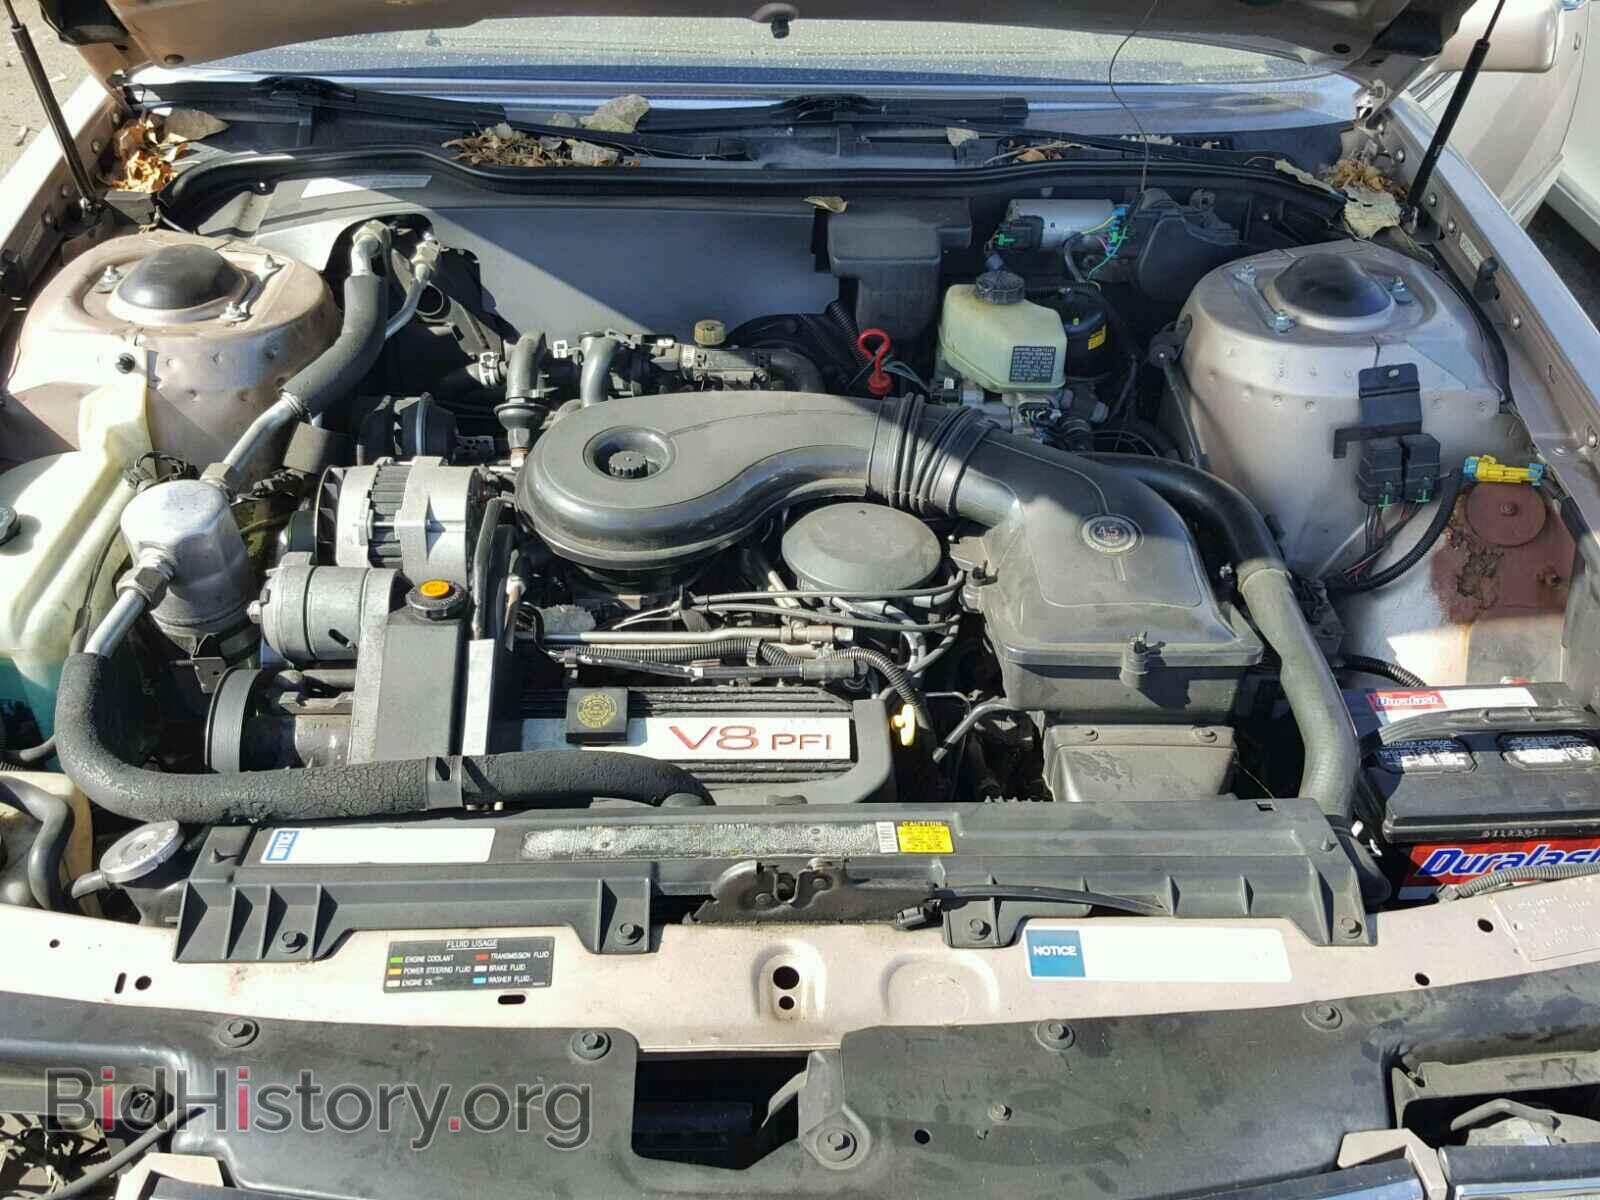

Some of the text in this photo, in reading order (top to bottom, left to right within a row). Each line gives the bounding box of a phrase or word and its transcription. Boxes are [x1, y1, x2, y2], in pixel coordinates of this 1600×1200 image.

[1376, 695, 1436, 706] Duralast
[669, 725, 832, 751] V8 PFI
[1415, 844, 1600, 877] Duralas
[447, 939, 497, 948] FLUID USAGE
[1033, 945, 1078, 956] NOTICE
[427, 954, 454, 962] COOLANT
[489, 963, 526, 972] BRAKE FLUID
